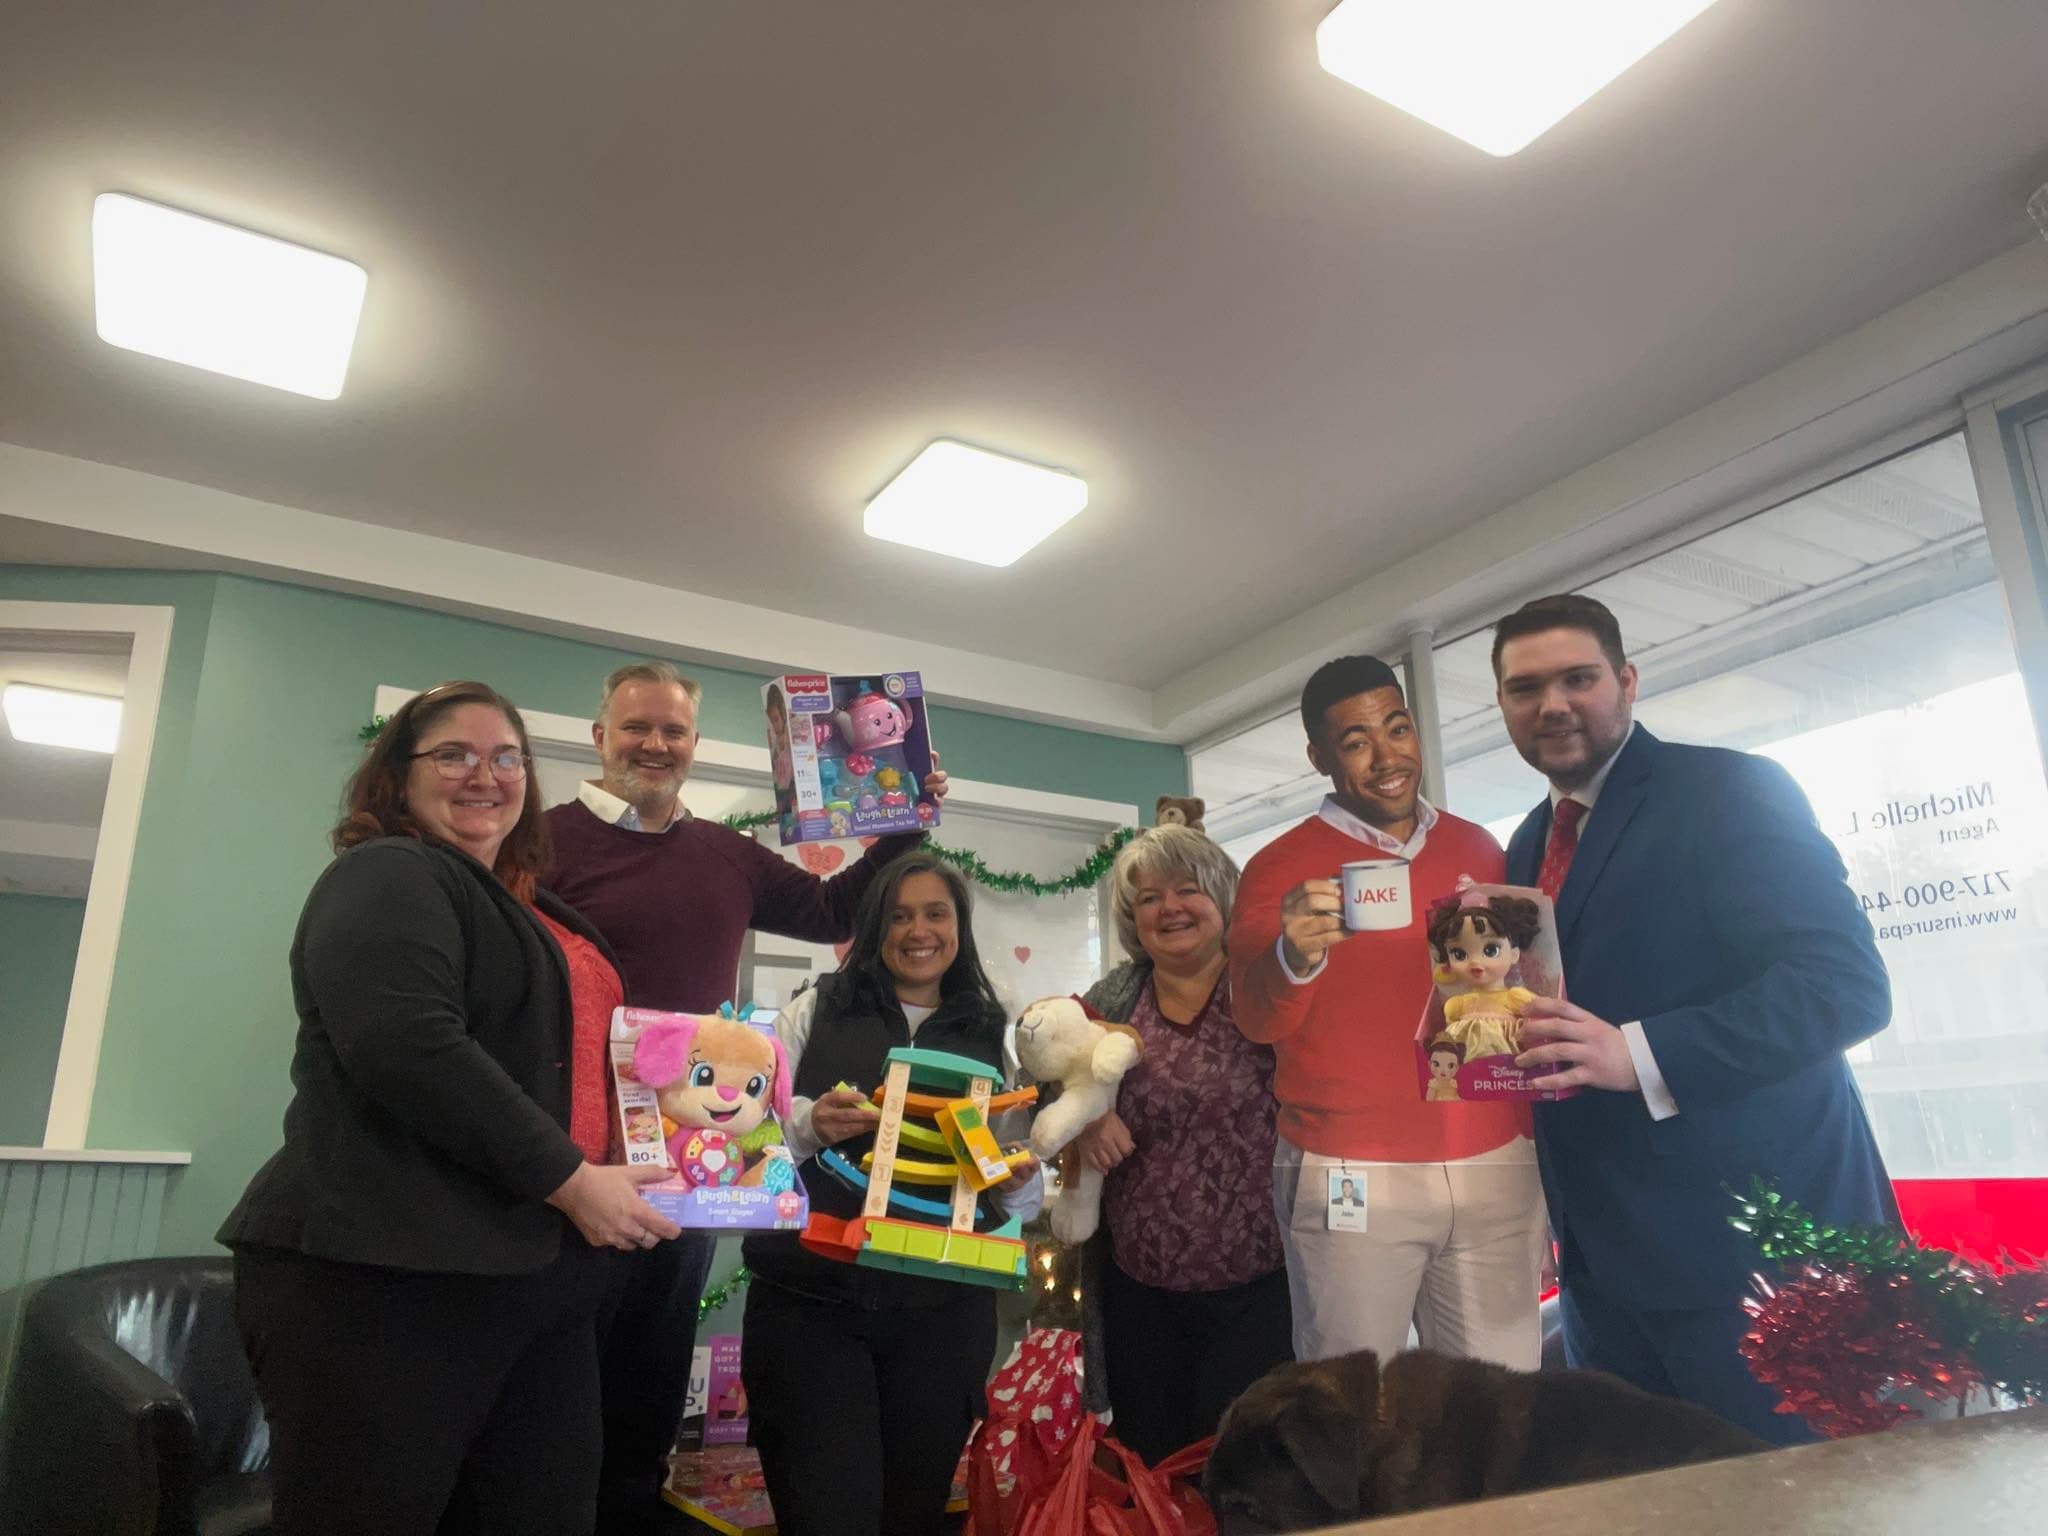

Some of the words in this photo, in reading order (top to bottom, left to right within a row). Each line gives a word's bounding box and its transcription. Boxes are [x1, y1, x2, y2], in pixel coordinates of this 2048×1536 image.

[1353, 887, 1399, 905] JAKE
[1473, 1079, 1535, 1092] PRINCES
[631, 1152, 658, 1162] 80+
